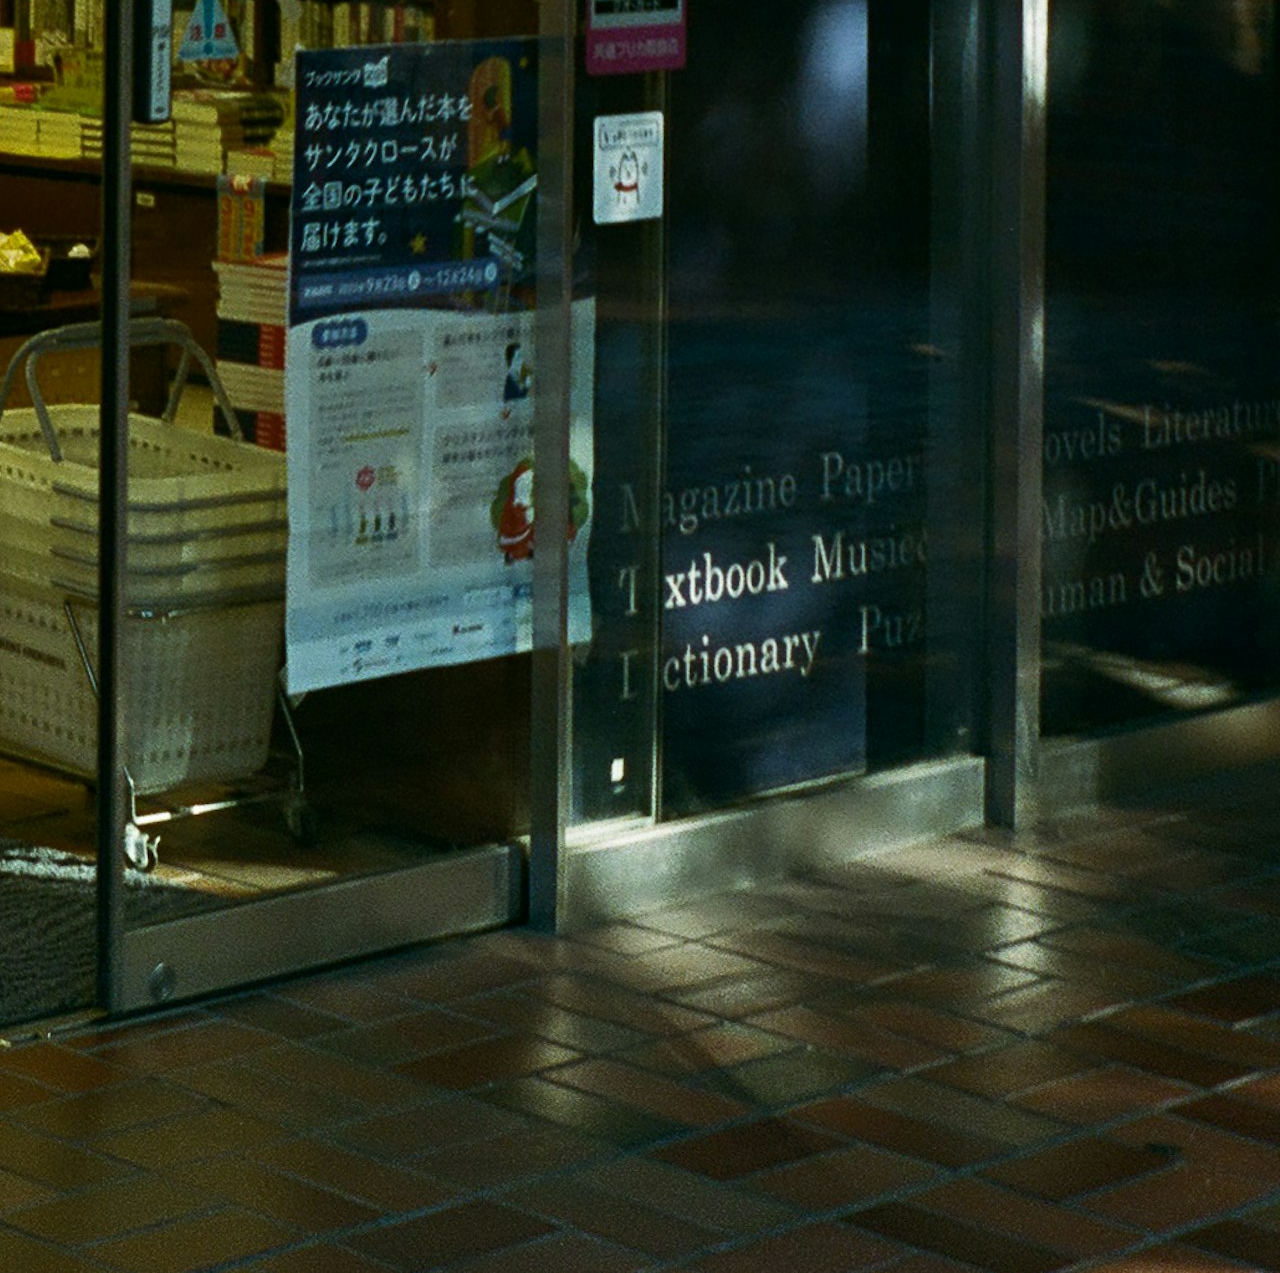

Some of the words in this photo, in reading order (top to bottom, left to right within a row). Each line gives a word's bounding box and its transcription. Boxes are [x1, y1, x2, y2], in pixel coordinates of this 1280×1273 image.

[304, 92, 474, 131] あなたが選んだ本を
[303, 132, 458, 171] サンタクロースが
[300, 173, 477, 211] 全国の子どもたちに
[299, 215, 388, 252] 届けます。
[618, 542, 790, 617] Txtbook
[619, 629, 823, 700] ctionary
